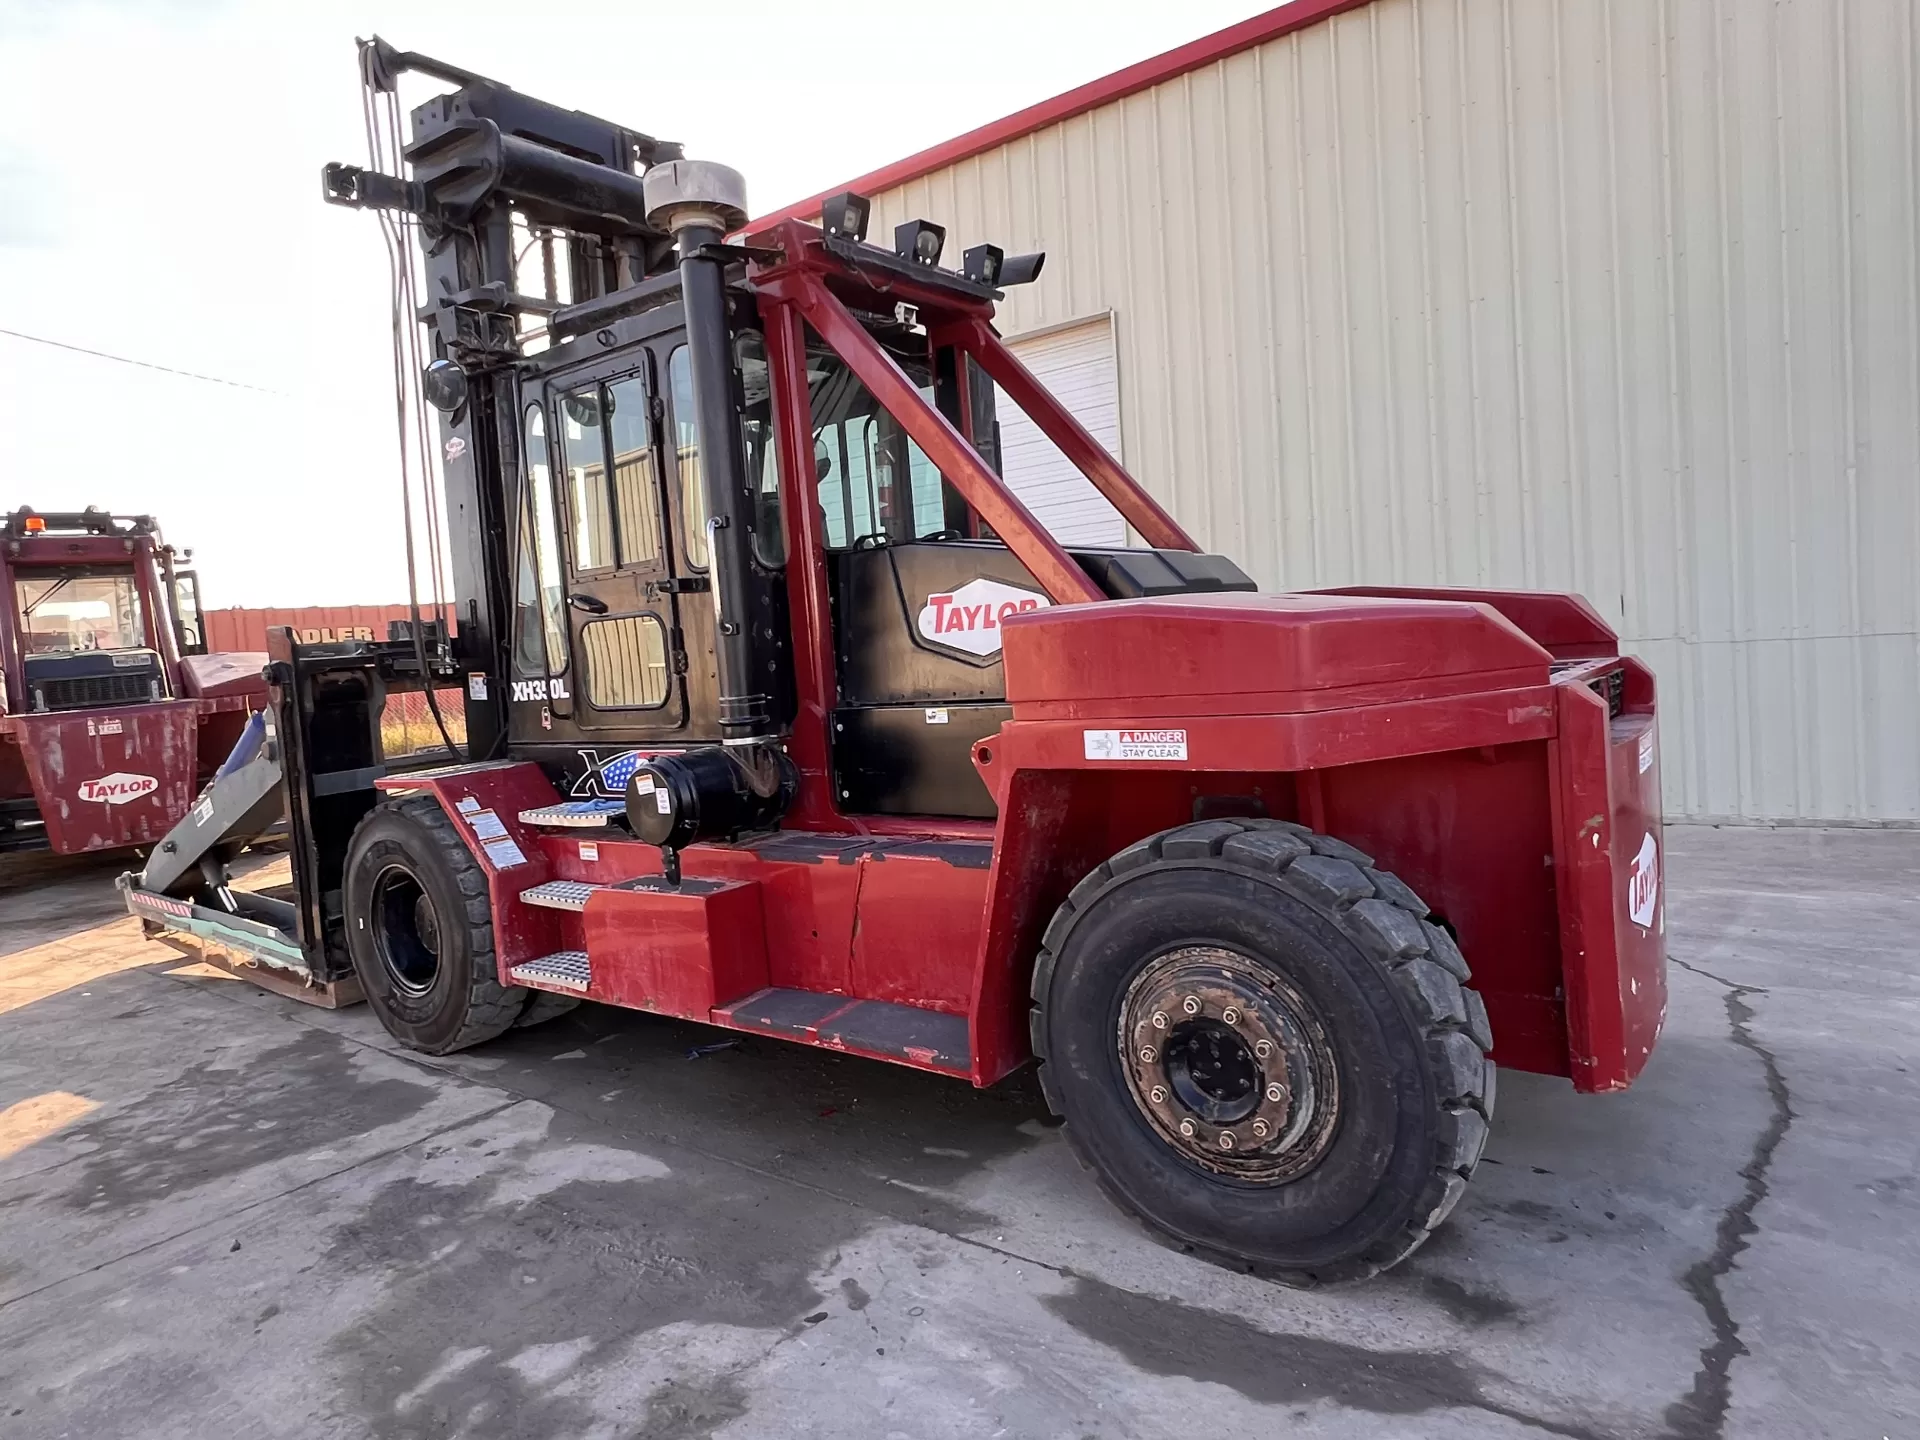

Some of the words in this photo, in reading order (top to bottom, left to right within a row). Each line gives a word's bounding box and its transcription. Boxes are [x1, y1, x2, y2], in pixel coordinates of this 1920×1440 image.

[1133, 732, 1183, 743] DANGER
[1122, 749, 1146, 758] STAY
[1147, 749, 1180, 758] CLEAR
[83, 780, 153, 799] TAYLOR
